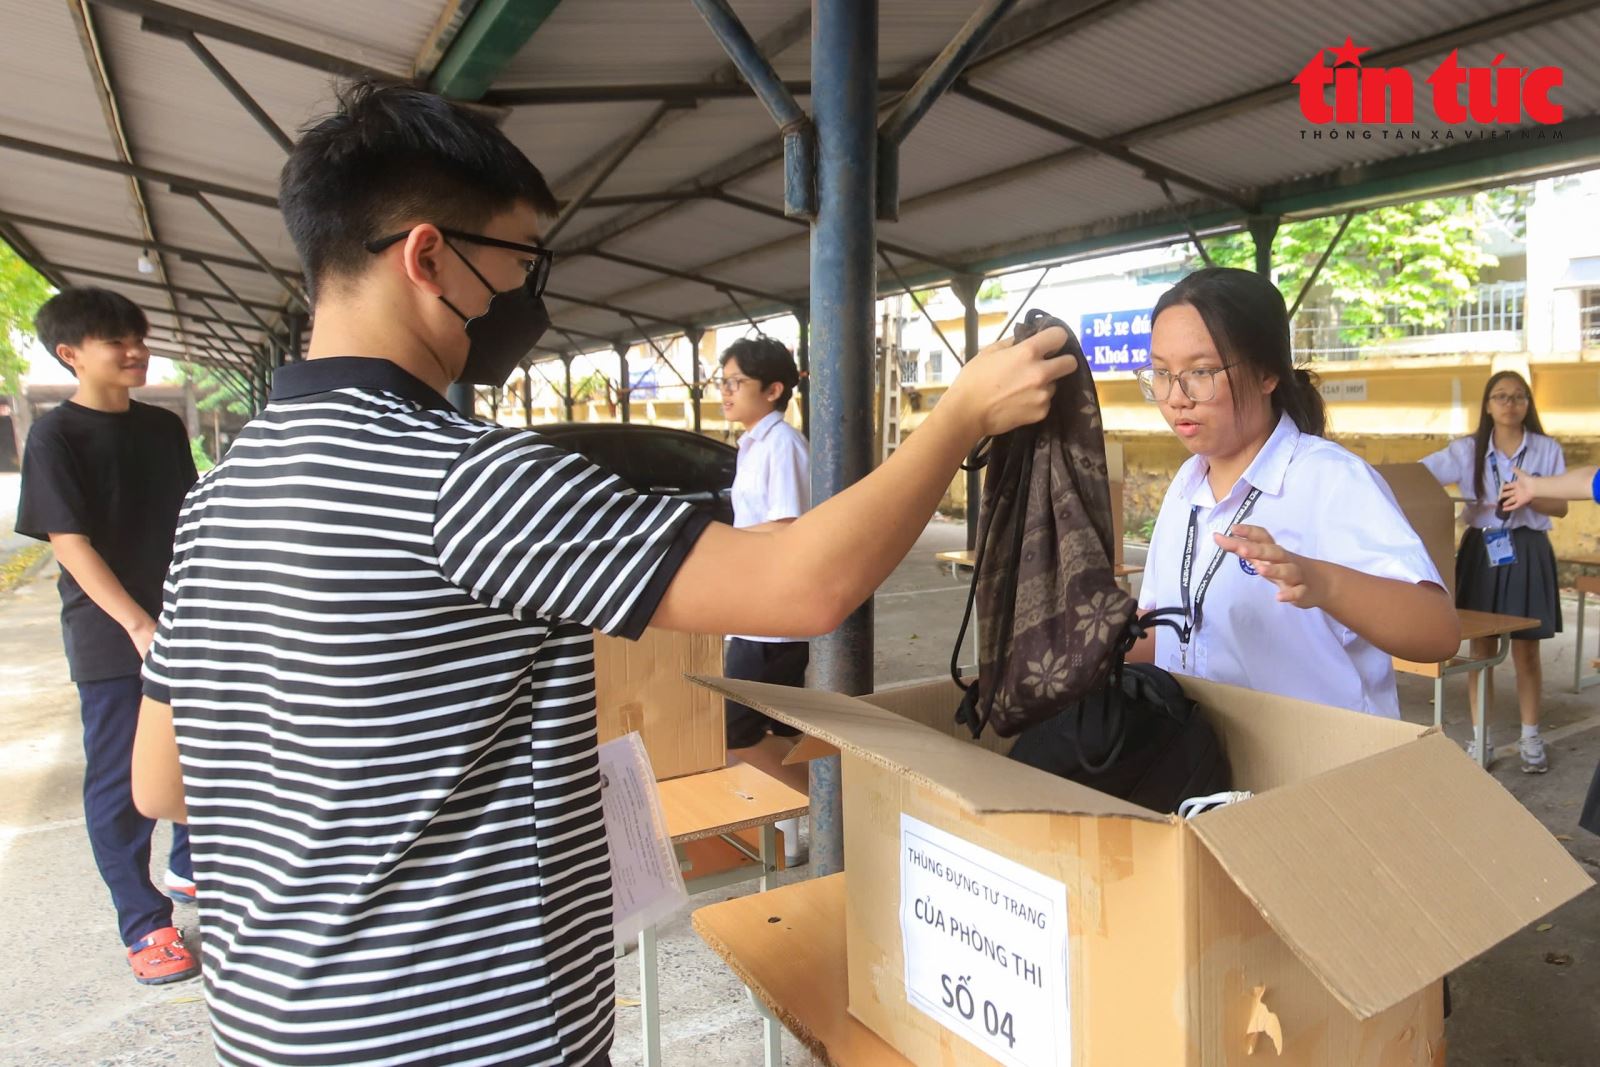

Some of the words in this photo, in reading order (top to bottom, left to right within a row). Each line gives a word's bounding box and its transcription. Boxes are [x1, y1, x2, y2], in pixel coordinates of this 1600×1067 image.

[1094, 344, 1129, 365] Khoá
[1131, 348, 1148, 363] xe
[1114, 321, 1130, 336] xe
[908, 847, 943, 878] THÙNG
[945, 867, 980, 896] ĐỰNG
[982, 885, 1000, 905] TƯ
[1002, 895, 1047, 929] TRANG
[914, 896, 946, 932] CỦA
[950, 917, 1008, 968] PHÒNG
[1012, 952, 1042, 988] THI
[941, 973, 975, 1020] SỐ
[983, 1000, 1016, 1049] 04
